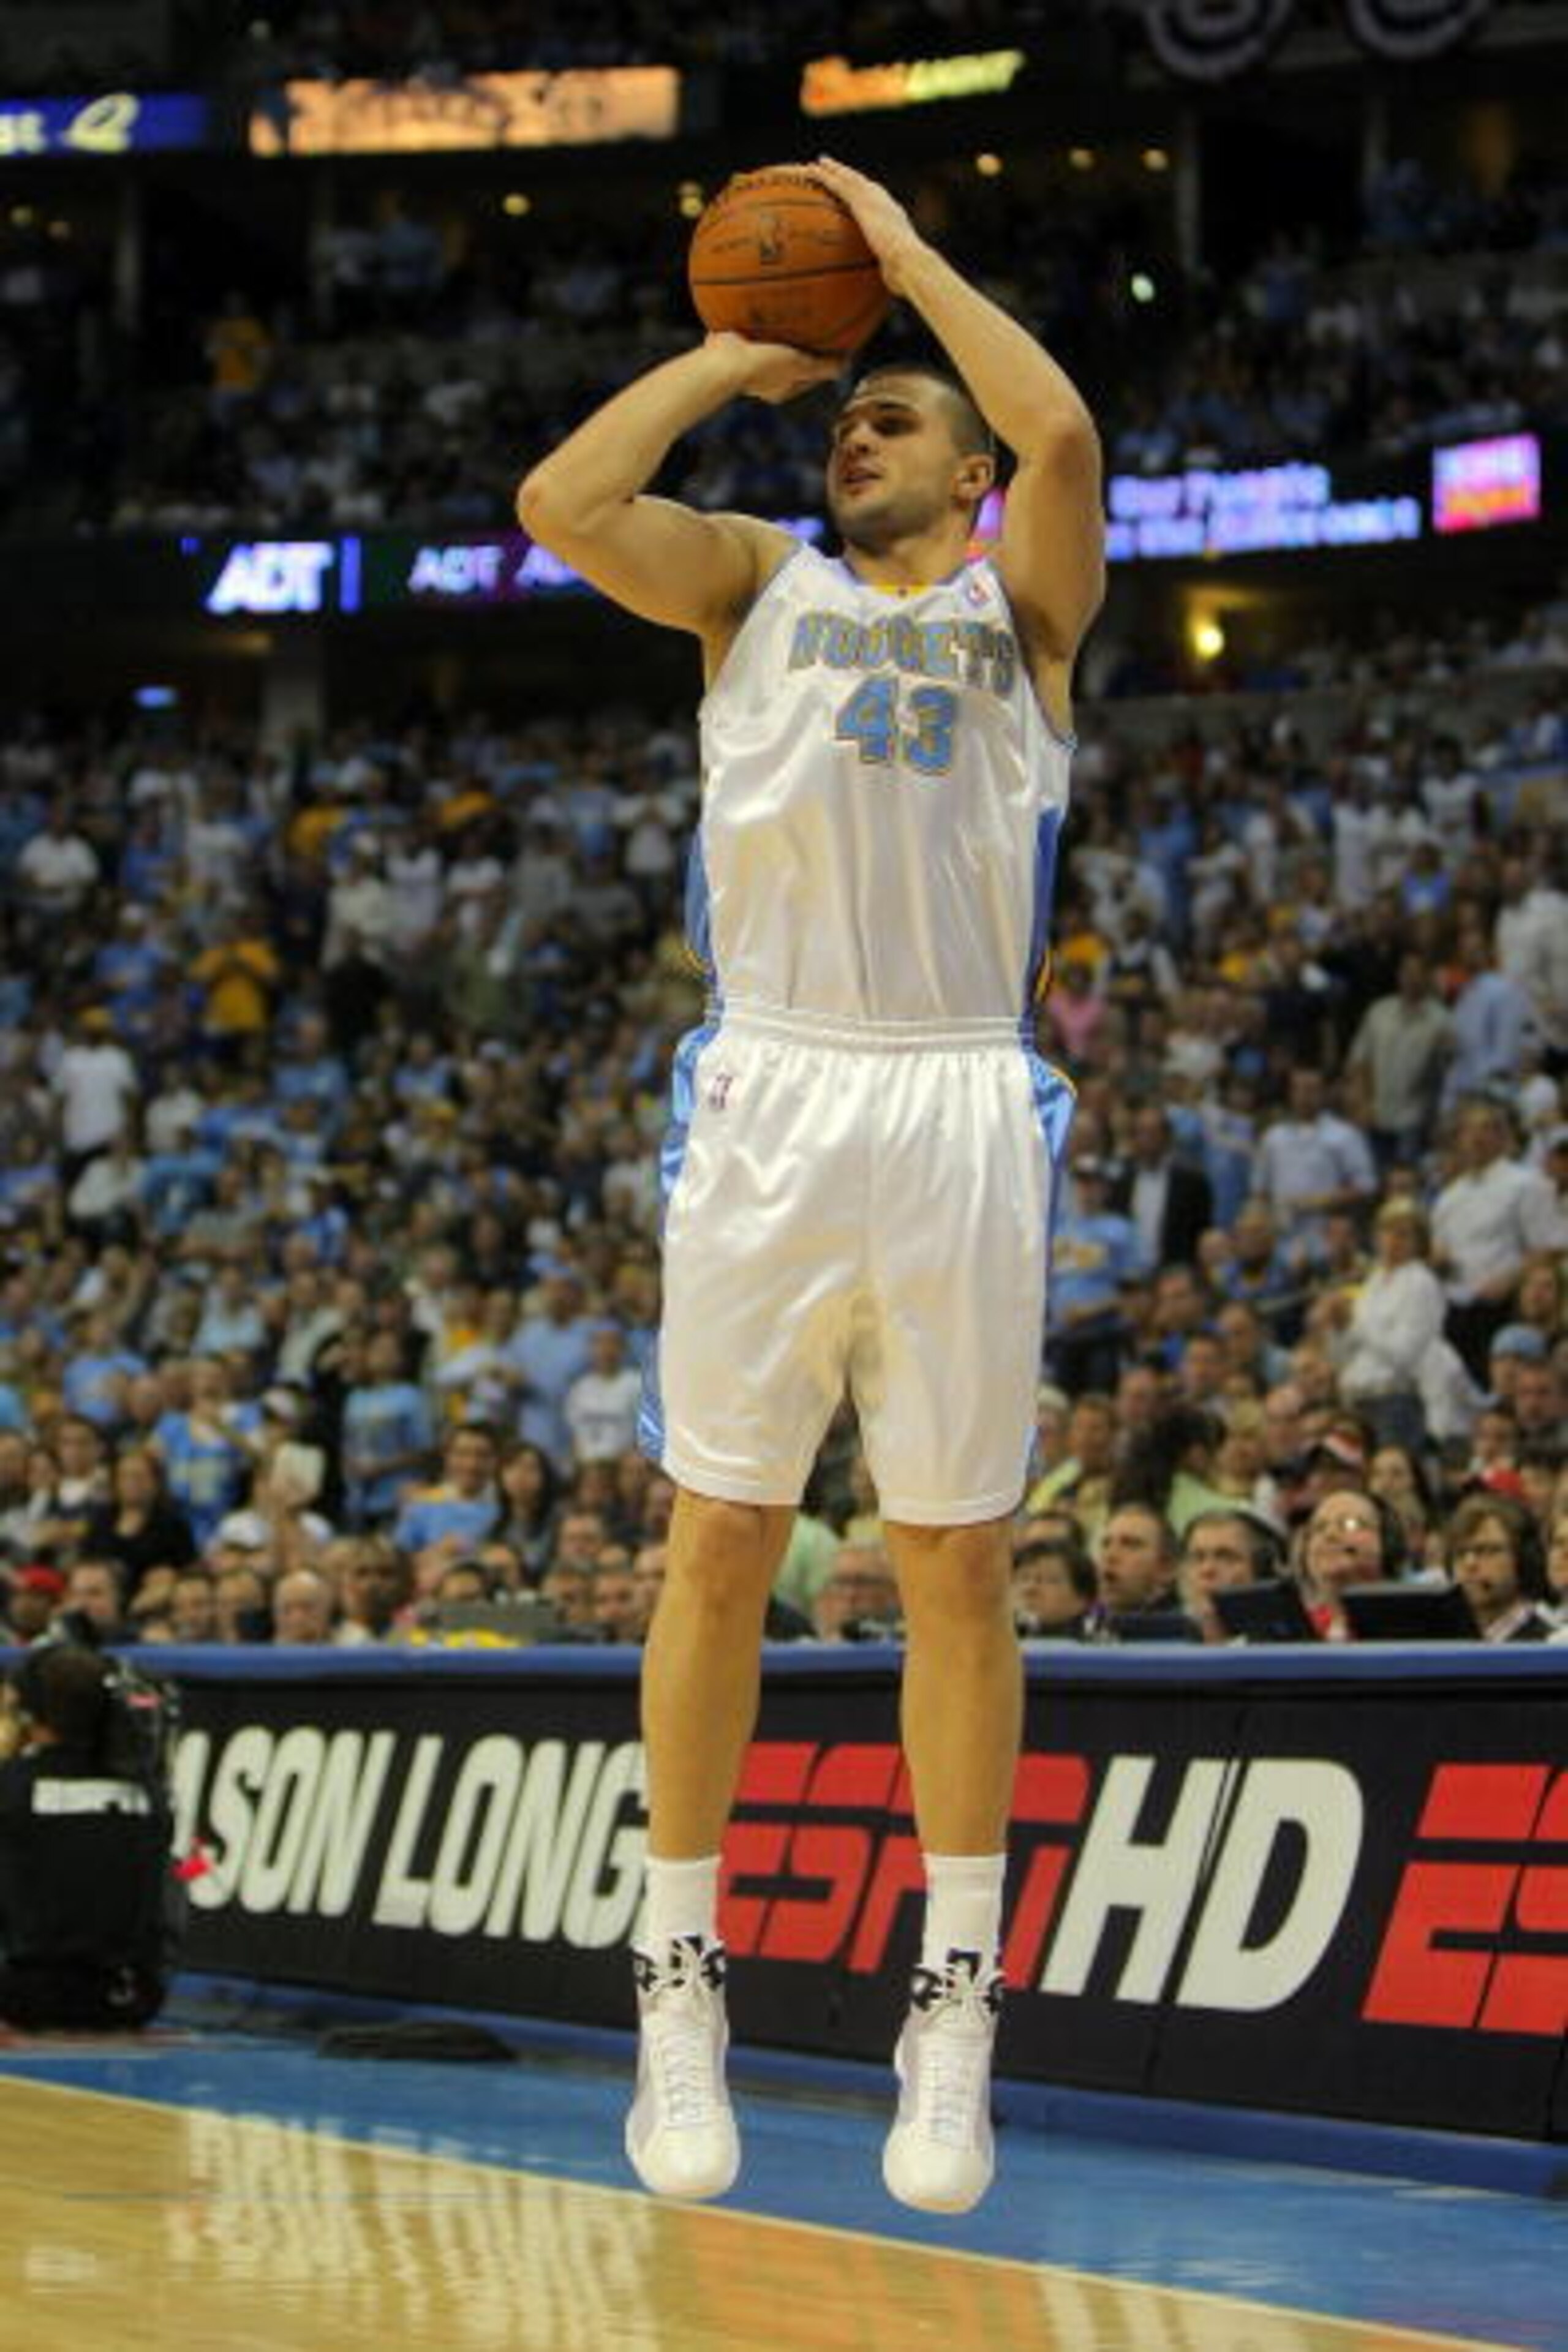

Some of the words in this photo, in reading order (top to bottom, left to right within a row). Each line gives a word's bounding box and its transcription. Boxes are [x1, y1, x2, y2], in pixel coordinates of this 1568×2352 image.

[207, 541, 332, 612] ADT
[409, 546, 501, 594] ADT
[788, 610, 1014, 697] NUGGETS
[835, 673, 956, 776] 43
